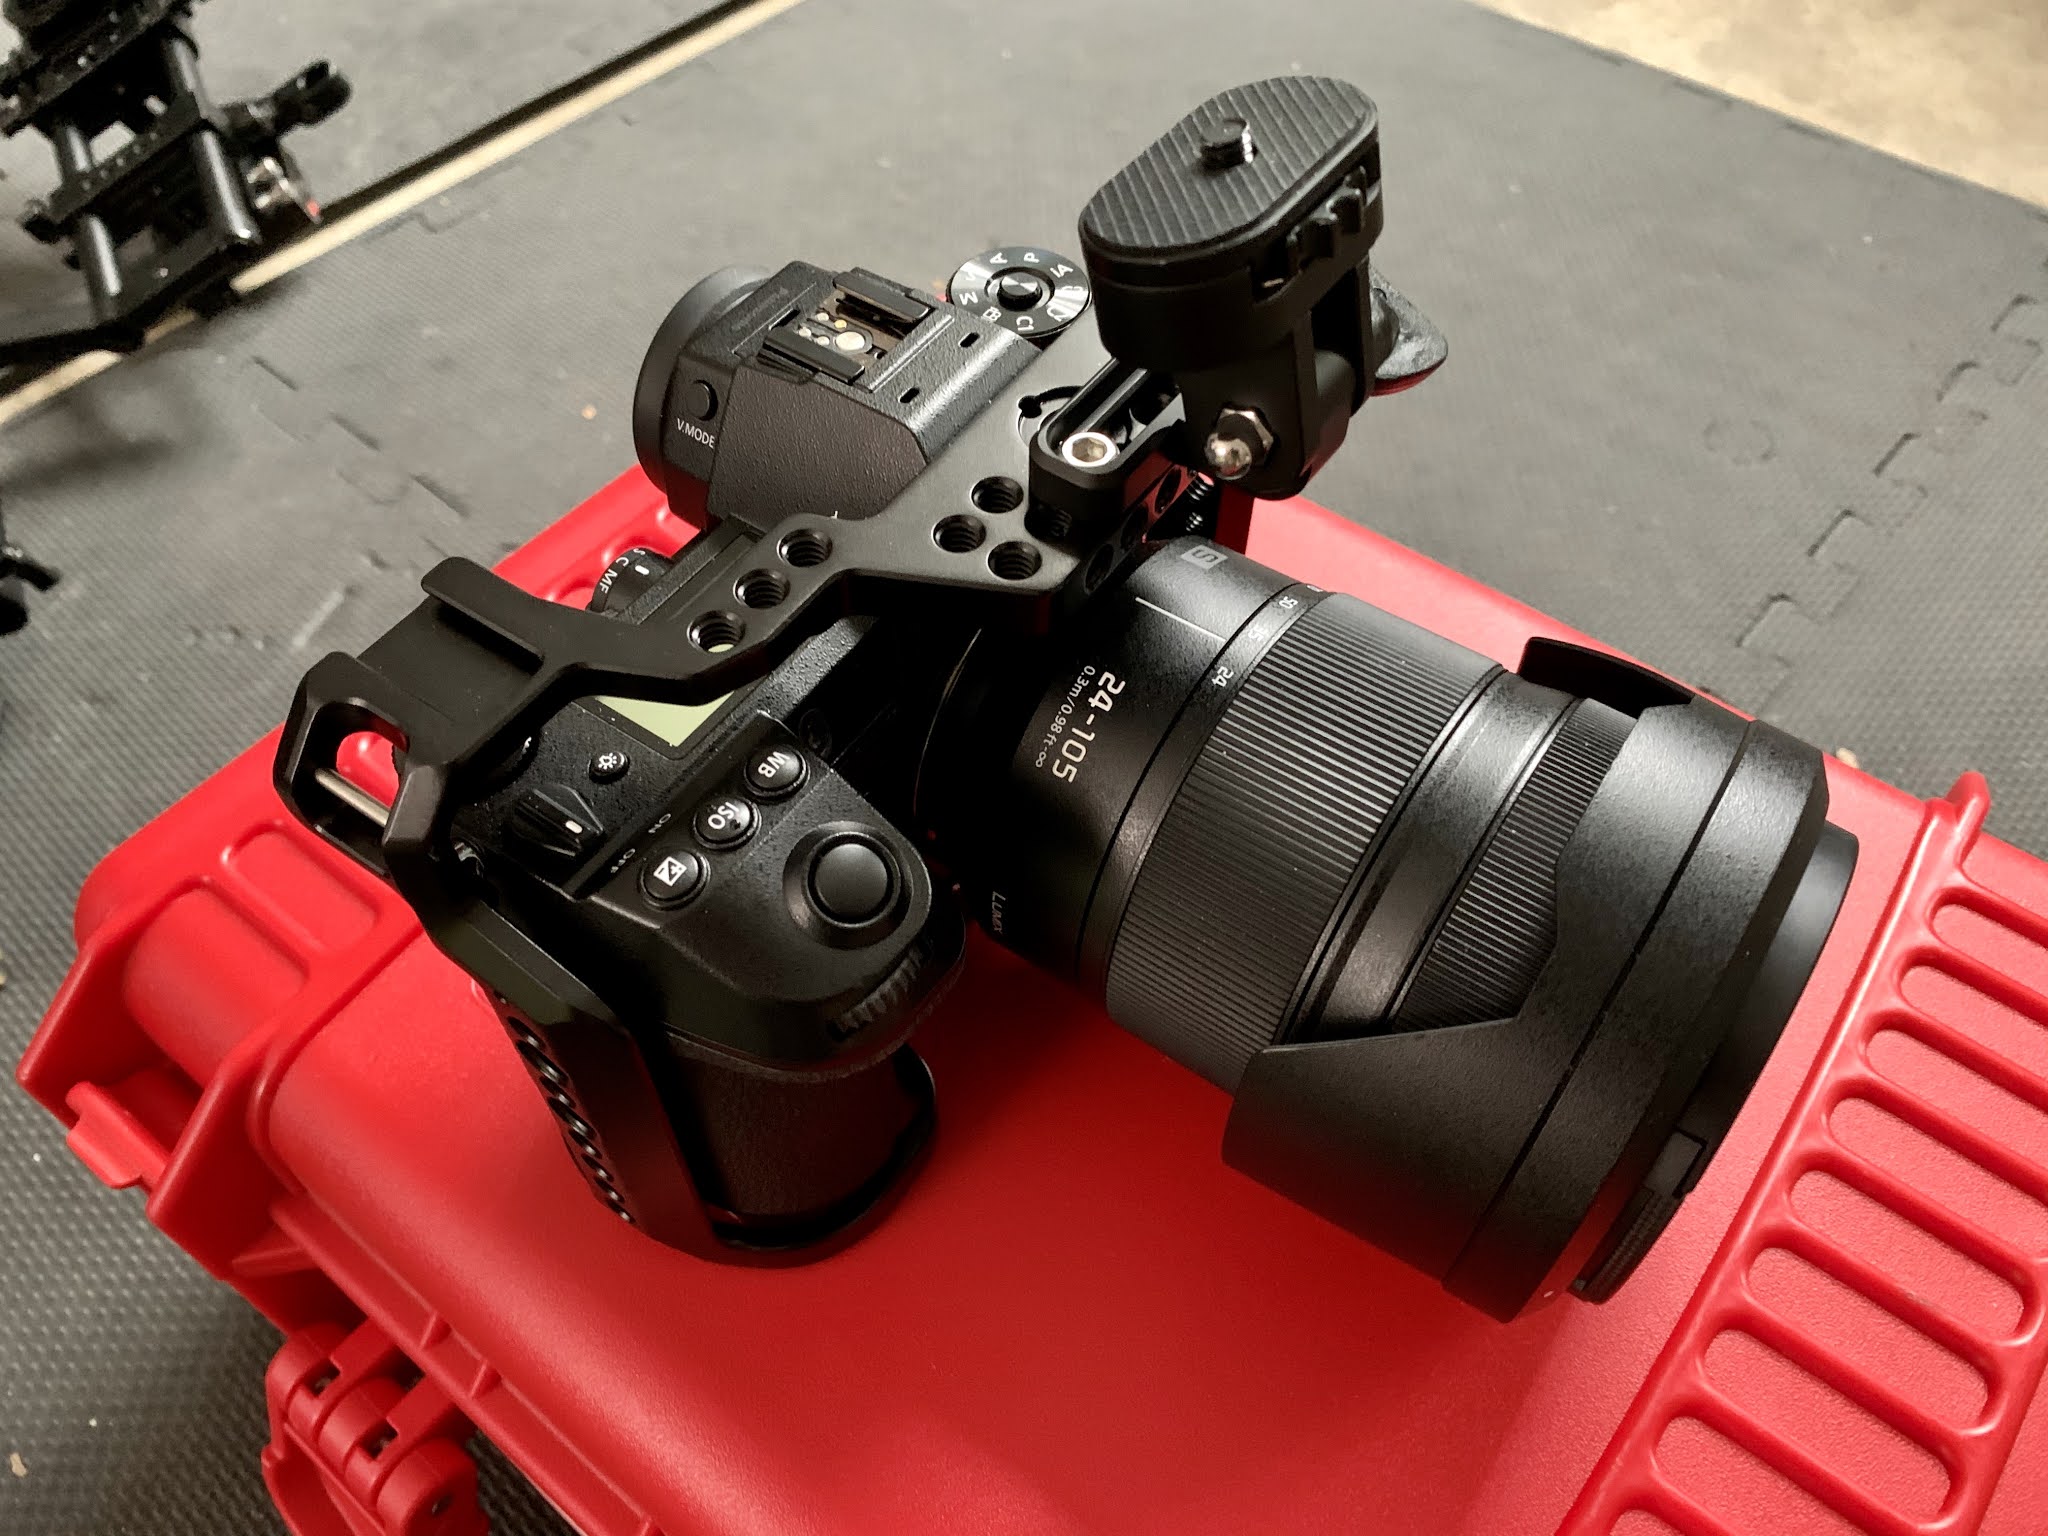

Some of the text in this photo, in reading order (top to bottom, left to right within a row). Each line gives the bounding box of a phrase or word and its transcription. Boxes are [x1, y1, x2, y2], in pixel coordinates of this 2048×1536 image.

[989, 252, 1008, 264] A
[1023, 252, 1040, 263] P
[1050, 263, 1074, 278] iA
[1016, 315, 1034, 331] C1
[676, 418, 715, 449] V.MODE
[615, 556, 630, 567] C
[600, 568, 618, 594] MF
[1211, 666, 1234, 687] 24
[1051, 671, 1126, 783] 24-105
[757, 751, 791, 778] WB
[707, 801, 740, 830] ISO
